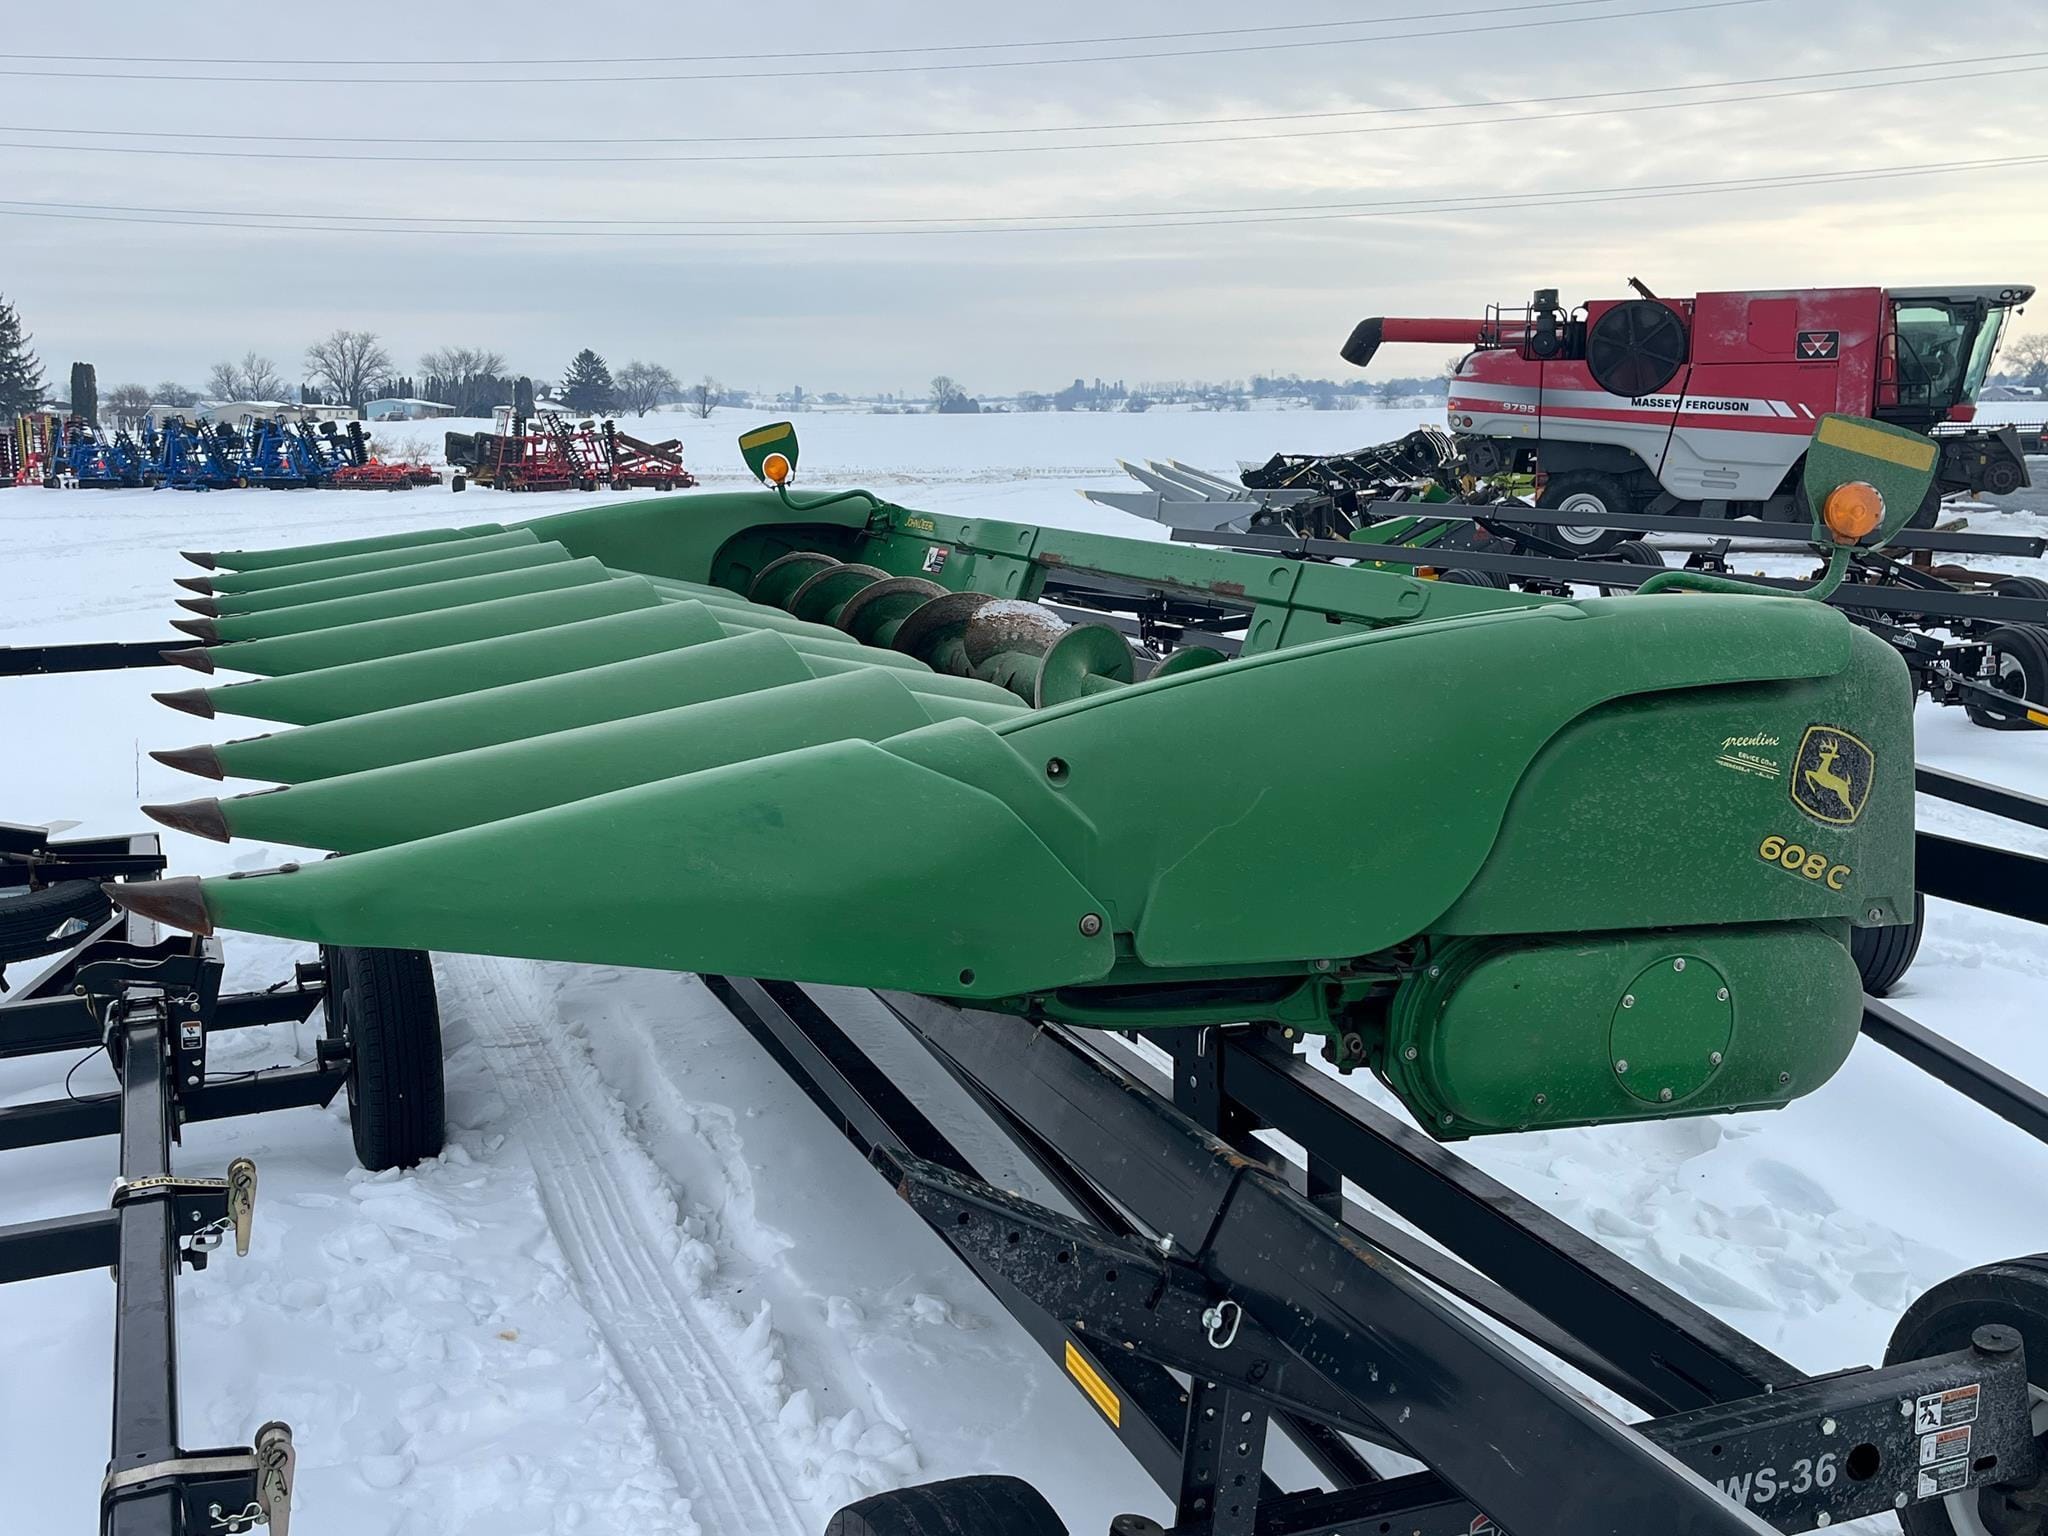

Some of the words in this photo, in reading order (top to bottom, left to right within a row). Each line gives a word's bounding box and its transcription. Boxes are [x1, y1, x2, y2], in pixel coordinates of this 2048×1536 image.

[1503, 402, 1536, 413] 9795
[1631, 397, 1679, 408] MASSEY
[1686, 400, 1749, 411] FERGUSON
[1716, 1453, 1837, 1506] WS-36
